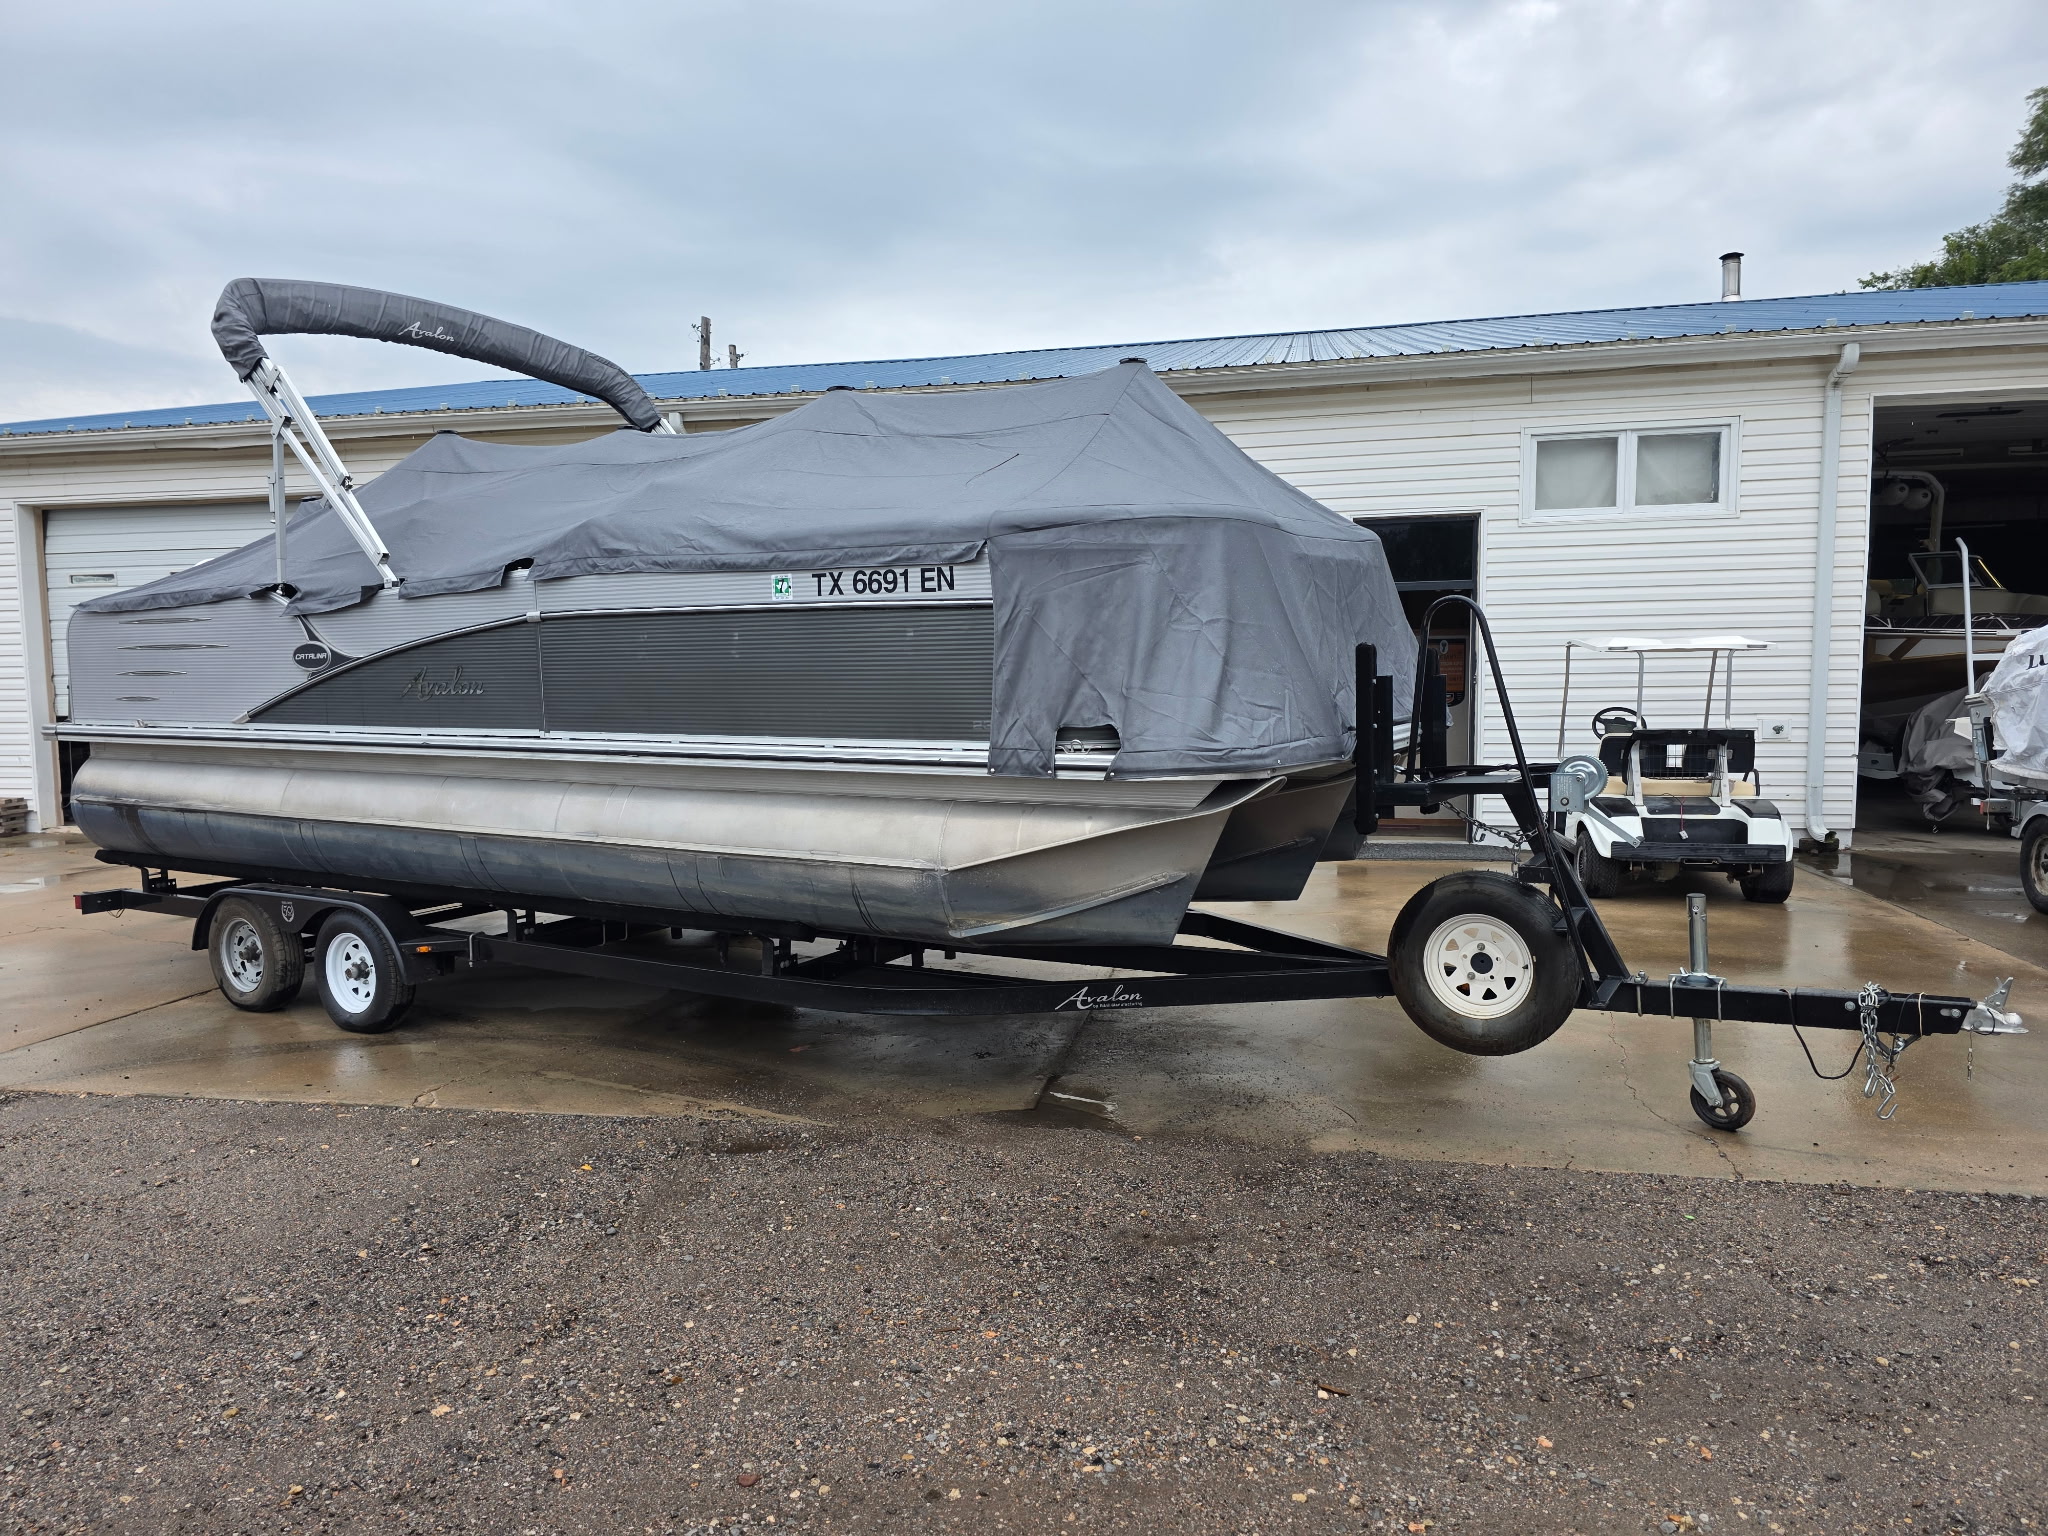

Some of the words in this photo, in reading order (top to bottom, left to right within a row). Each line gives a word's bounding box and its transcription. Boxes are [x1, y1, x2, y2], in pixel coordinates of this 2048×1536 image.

[398, 321, 455, 342] Avalon
[811, 571, 845, 597] TX
[852, 568, 909, 595] 6691
[920, 565, 955, 593] EN
[295, 652, 328, 660] CATALINA
[400, 665, 485, 702] Avalon
[1054, 984, 1142, 1010] Avalon
